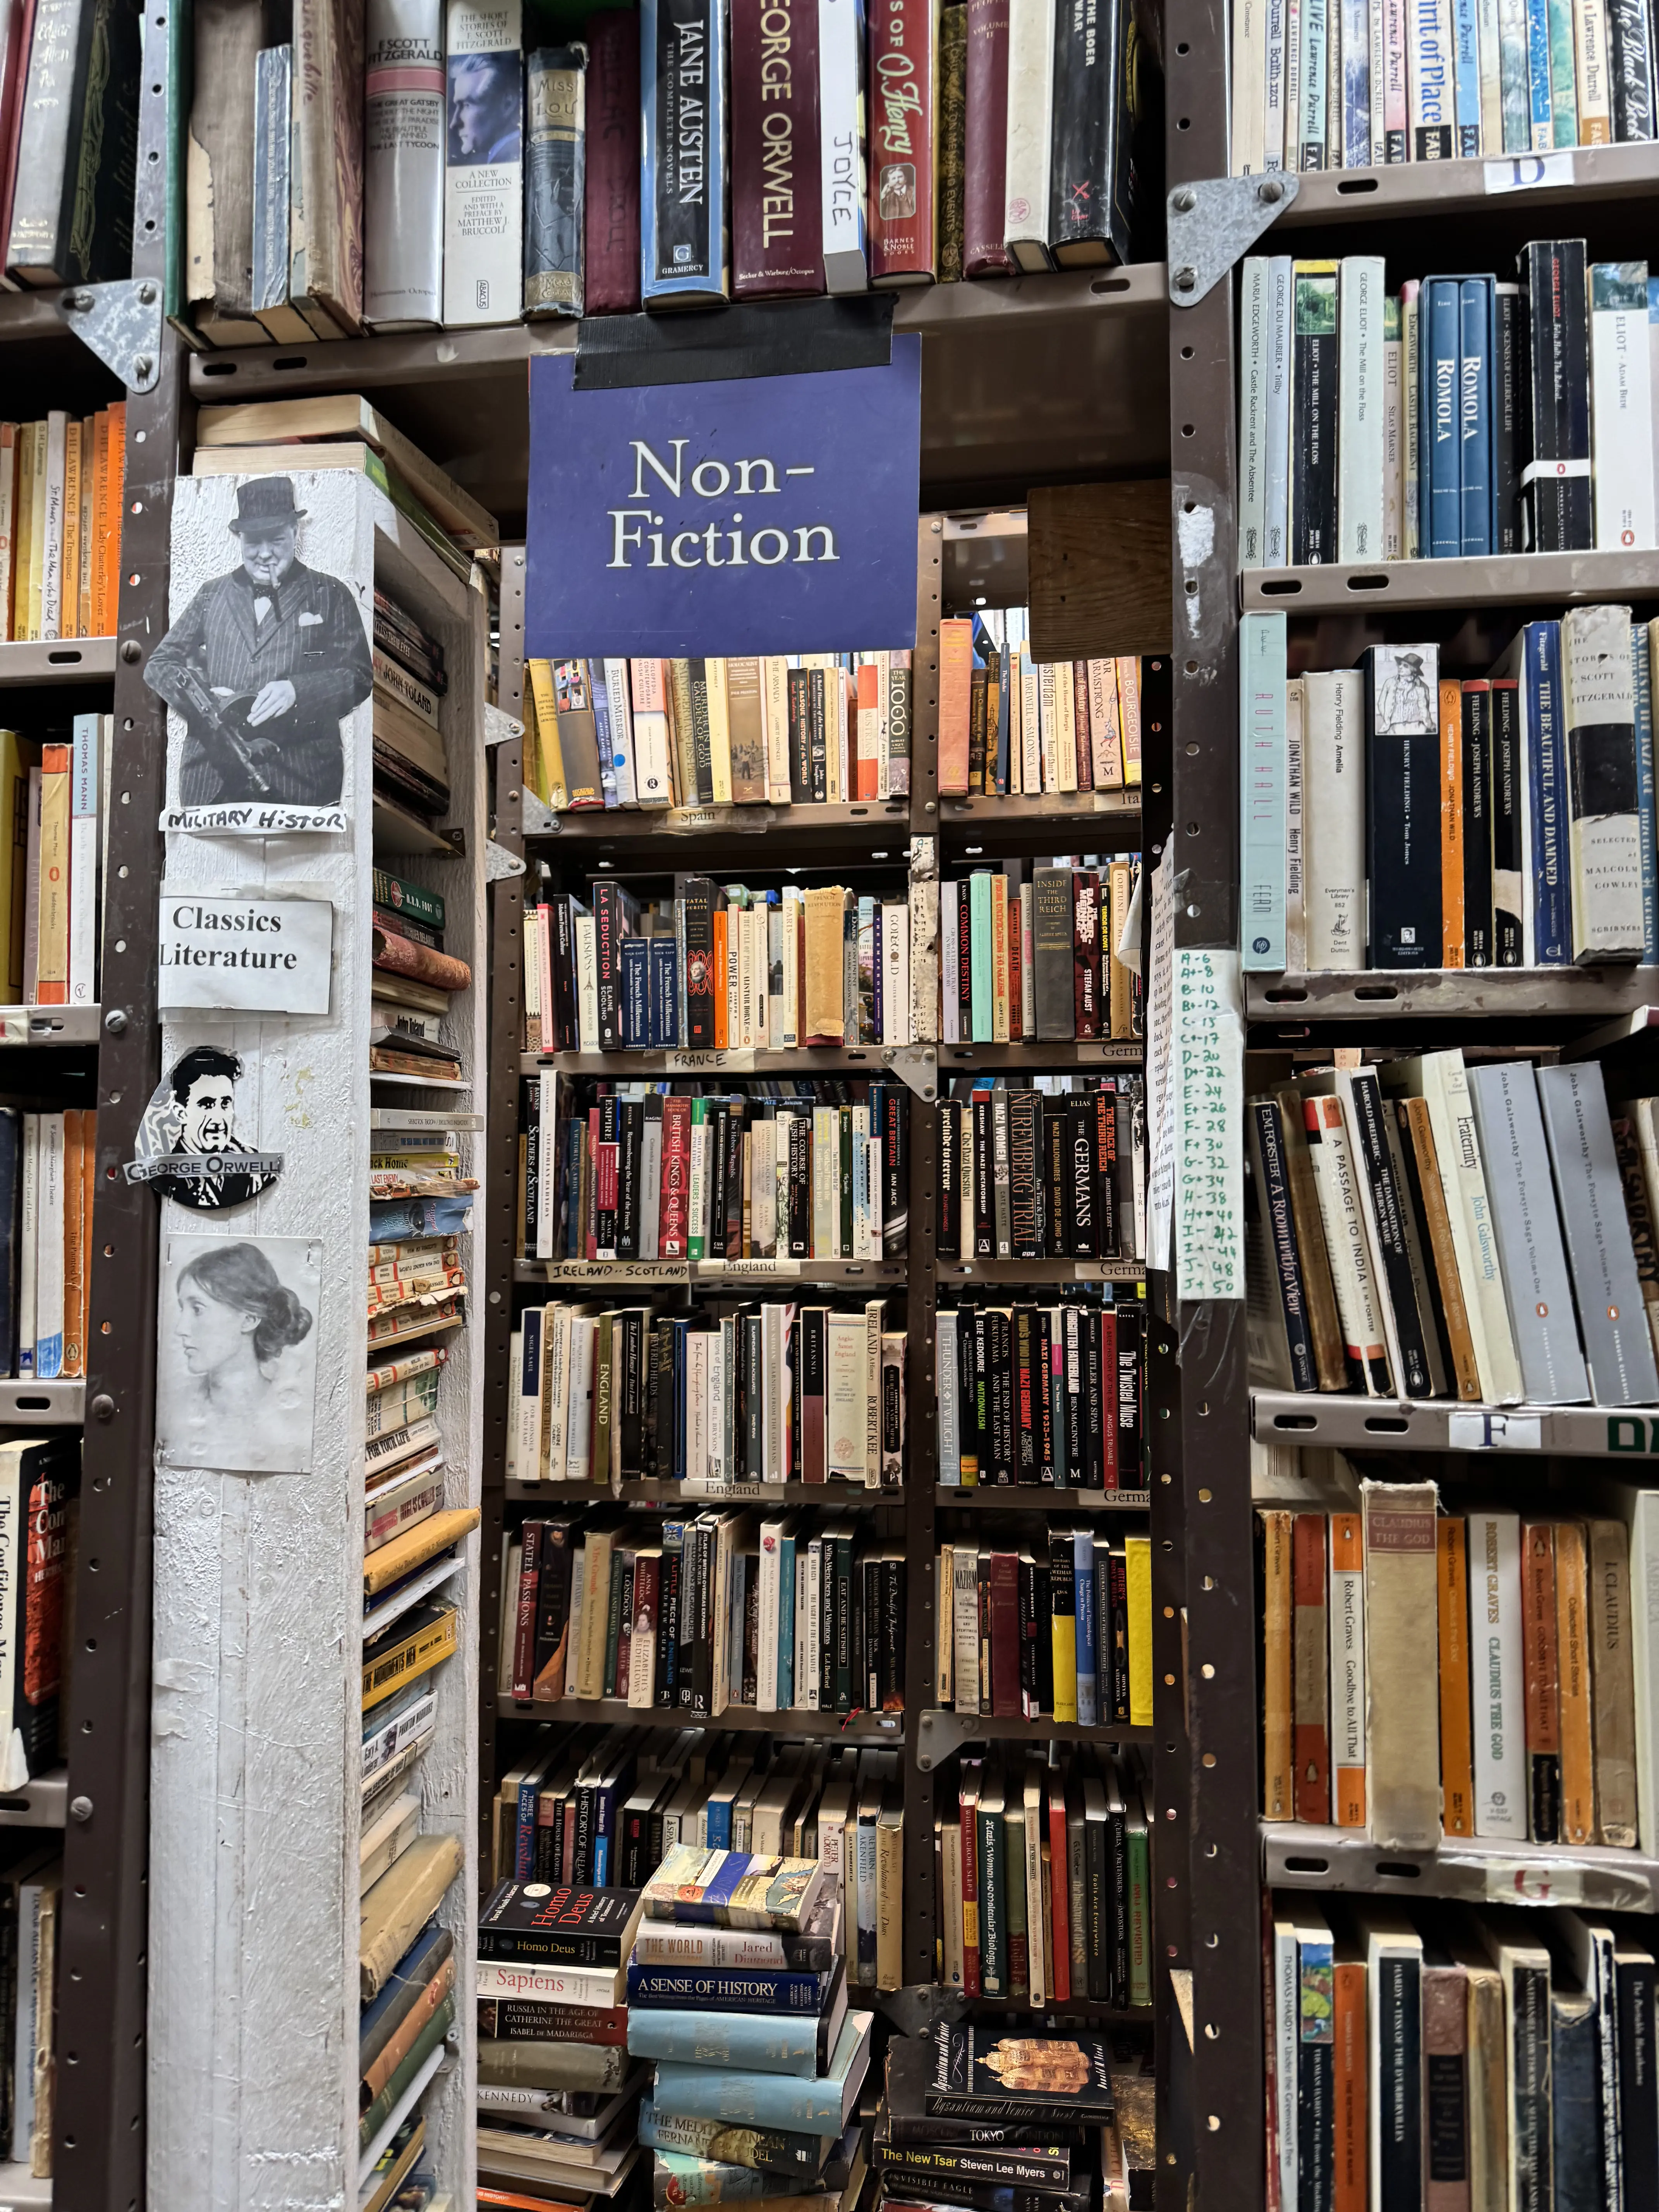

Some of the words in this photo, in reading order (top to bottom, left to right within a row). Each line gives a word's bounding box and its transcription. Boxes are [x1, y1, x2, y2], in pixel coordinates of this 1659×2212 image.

[890, 20, 903, 47] OF
[1290, 20, 1299, 64] LAWRENCE
[673, 19, 704, 88] JANE
[879, 81, 922, 154] Henry
[679, 95, 703, 205] AUSTEN
[456, 178, 512, 189] COLLECTION
[470, 171, 475, 179] A
[478, 170, 498, 179] NEW
[762, 113, 793, 249] ORWELL
[833, 132, 856, 226] JOYCE
[1510, 156, 1545, 186] D
[462, 225, 506, 236] BRUCCOLI
[662, 265, 703, 275] GRAMERCY
[1252, 303, 1260, 358] EDGEWORTH
[1359, 378, 1365, 386] on
[1436, 359, 1455, 443] ROMOLA
[1462, 356, 1481, 441] ROMOLA
[628, 439, 814, 498] Non-
[606, 510, 840, 568] Fiction
[383, 665, 403, 694] JOHN
[405, 683, 431, 714] TOLAND
[611, 670, 620, 702] BURIED
[1334, 683, 1344, 711] Henry
[694, 681, 702, 724] GARDEN
[700, 681, 709, 726] MURDER
[614, 704, 625, 740] MIRROR
[697, 727, 703, 740] OF
[703, 730, 710, 742] IN
[1255, 693, 1273, 748] RUTH
[1334, 712, 1344, 741] Fielding
[81, 727, 89, 774] THOMAS
[1334, 744, 1344, 774] Amelia
[80, 777, 88, 811] MANN
[1254, 766, 1273, 821] HALL
[168, 809, 252, 829] MILITARY
[681, 812, 716, 825] Spain
[600, 889, 608, 903] LA
[173, 906, 281, 933] Classics
[960, 905, 969, 954] COMMON
[159, 943, 297, 970] Literature
[600, 908, 610, 979] SEDUCTION
[961, 957, 969, 1002] DESTINY
[674, 1053, 726, 1067] FRANCE
[670, 1115, 681, 1153] BRITISH
[889, 1132, 897, 1166] BRITAIN
[1009, 1093, 1034, 1193] NUREMBERG
[1333, 1139, 1342, 1148] A
[1458, 1116, 1476, 1170] Fraternity
[127, 1162, 201, 1181] GEORGE
[206, 1156, 279, 1173] ORWELL
[371, 1175, 383, 1184] LAST
[384, 1174, 398, 1183] ENEMY
[670, 1155, 680, 1186] KINGS
[1074, 1138, 1091, 1226] GERMANS
[1336, 1155, 1354, 1213] PASSAGE
[670, 1188, 680, 1198] &
[1472, 1195, 1486, 1222] John
[667, 1199, 680, 1237] QUEENS
[1013, 1198, 1036, 1246] TRIAL
[1348, 1219, 1358, 1237] TO
[722, 1261, 776, 1274] England
[1352, 1243, 1367, 1282] INDIA
[1475, 1224, 1497, 1282] Galsworthy
[553, 1266, 613, 1278] IRELAND
[626, 1266, 688, 1277] SCOTLAND
[942, 1336, 953, 1392] THUNDER
[1119, 1351, 1137, 1367] The
[598, 1364, 609, 1425] ENGLAND
[1119, 1368, 1135, 1404] Twisted
[943, 1400, 954, 1455] TWILIGHT
[1120, 1405, 1134, 1428] Muse
[1478, 1414, 1509, 1447] F
[706, 1482, 760, 1499] England
[956, 1570, 977, 1589] NAZISM
[1345, 1580, 1354, 1614] Robert
[1345, 1616, 1355, 1650] Graves
[1346, 1661, 1356, 1703] Goodbye
[1347, 1705, 1356, 1716] to
[1348, 1717, 1357, 1734] All
[1348, 1736, 1357, 1757] That
[1514, 1869, 1553, 1900] G
[531, 1888, 572, 1927] Homo
[558, 1893, 594, 1925] Deus
[517, 1941, 548, 1952] Homo
[550, 1943, 575, 1954] Deus
[646, 1939, 664, 1953] THE
[668, 1939, 704, 1954] WORLD
[742, 1942, 772, 1953] Jared
[496, 1969, 564, 1992] Sapiens
[638, 1979, 648, 1990] A
[651, 1978, 692, 1993] SENSE
[696, 1981, 715, 1994] OF
[717, 1981, 778, 1996] HISTORY
[1284, 1955, 1293, 2000] THOMAS
[1283, 2002, 1292, 2033] HARDY
[882, 2148, 902, 2161] The
[906, 2152, 929, 2164] New
[933, 2154, 957, 2167] Tsar
[960, 2158, 993, 2171] Steven
[996, 2162, 1013, 2175] Lee
[1017, 2165, 1045, 2179] Myers
